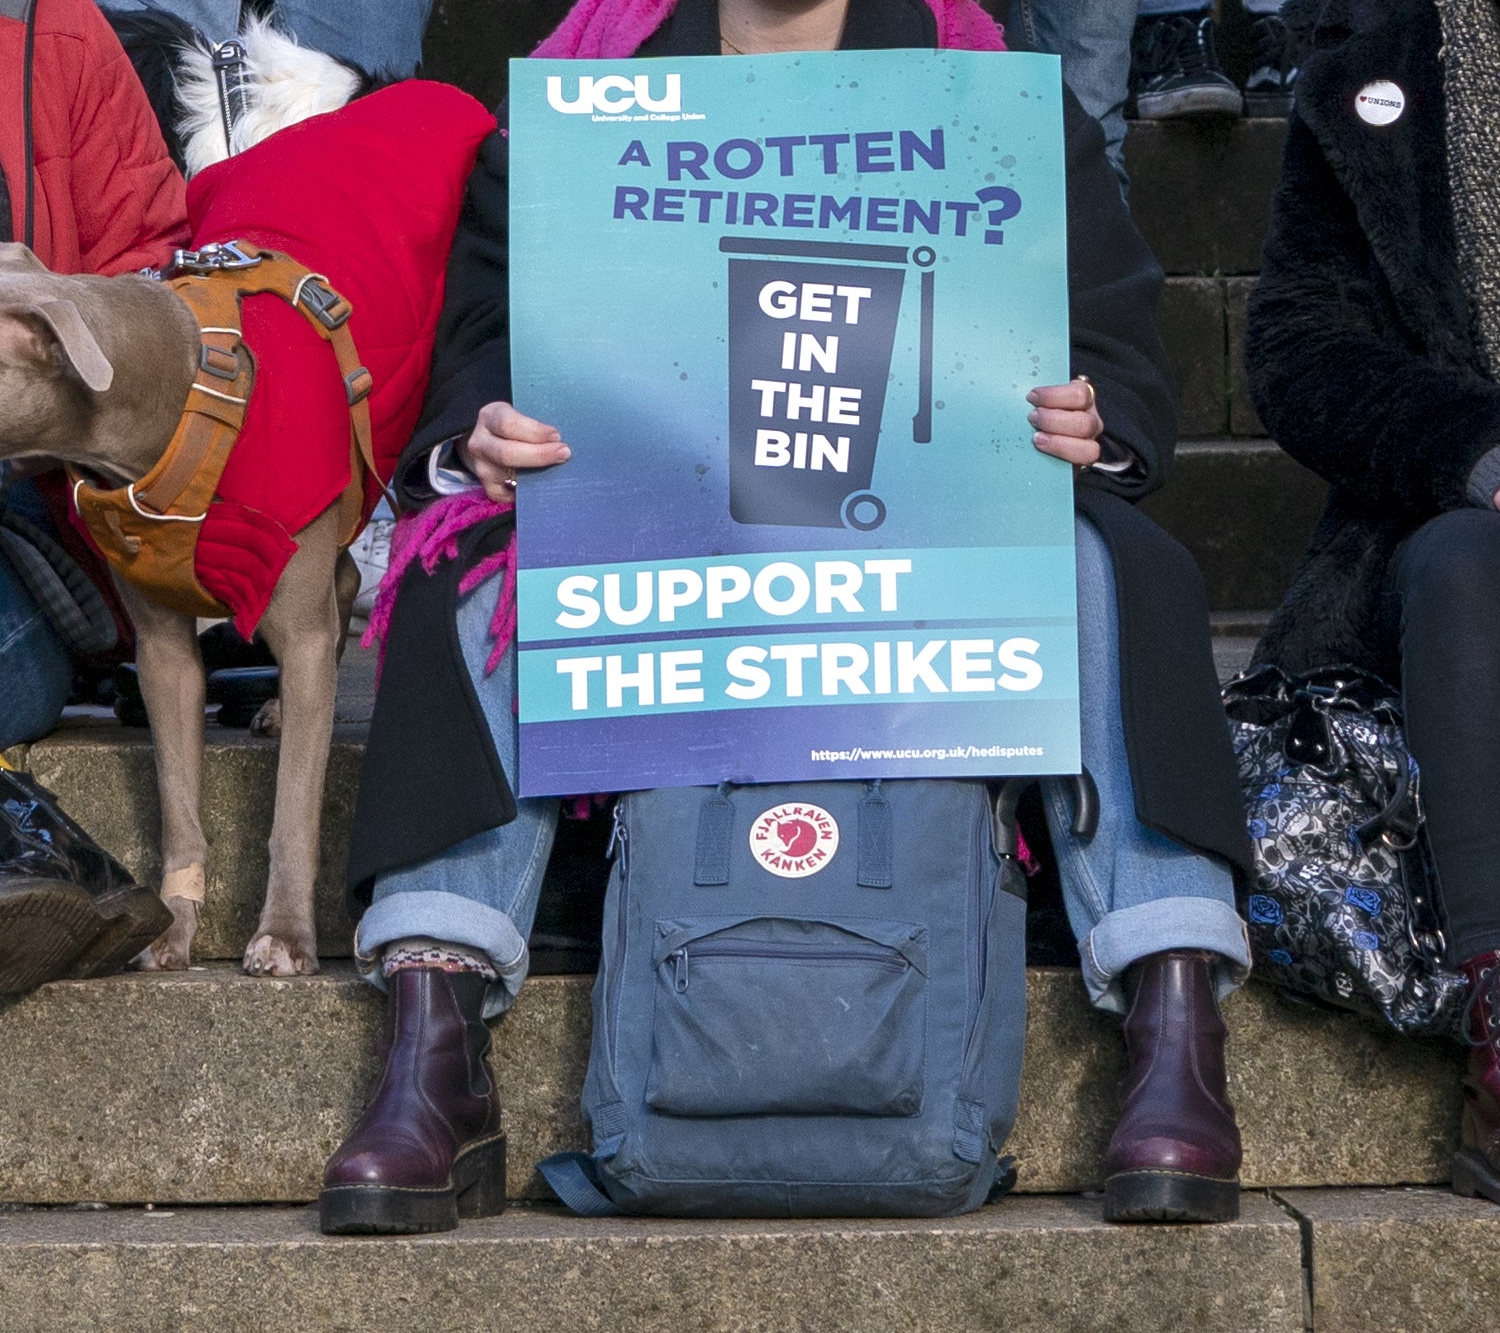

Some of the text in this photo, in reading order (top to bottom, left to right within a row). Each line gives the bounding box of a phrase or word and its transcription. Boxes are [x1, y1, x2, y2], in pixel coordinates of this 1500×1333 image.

[546, 74, 681, 114] UCU
[1367, 97, 1402, 110] UNIONS
[592, 112, 706, 123] University and College Union
[619, 129, 946, 182] A ROTTEN
[613, 185, 1023, 246] RETIREMENT?
[757, 280, 872, 324] GET
[780, 331, 838, 373] IN
[750, 379, 862, 426] THE
[754, 429, 851, 473] BIN
[555, 559, 912, 630] SUPPORT
[555, 637, 1044, 712] THE STRIKES
[810, 744, 1044, 764] https://www.ucu.org.uk/hedisputes
